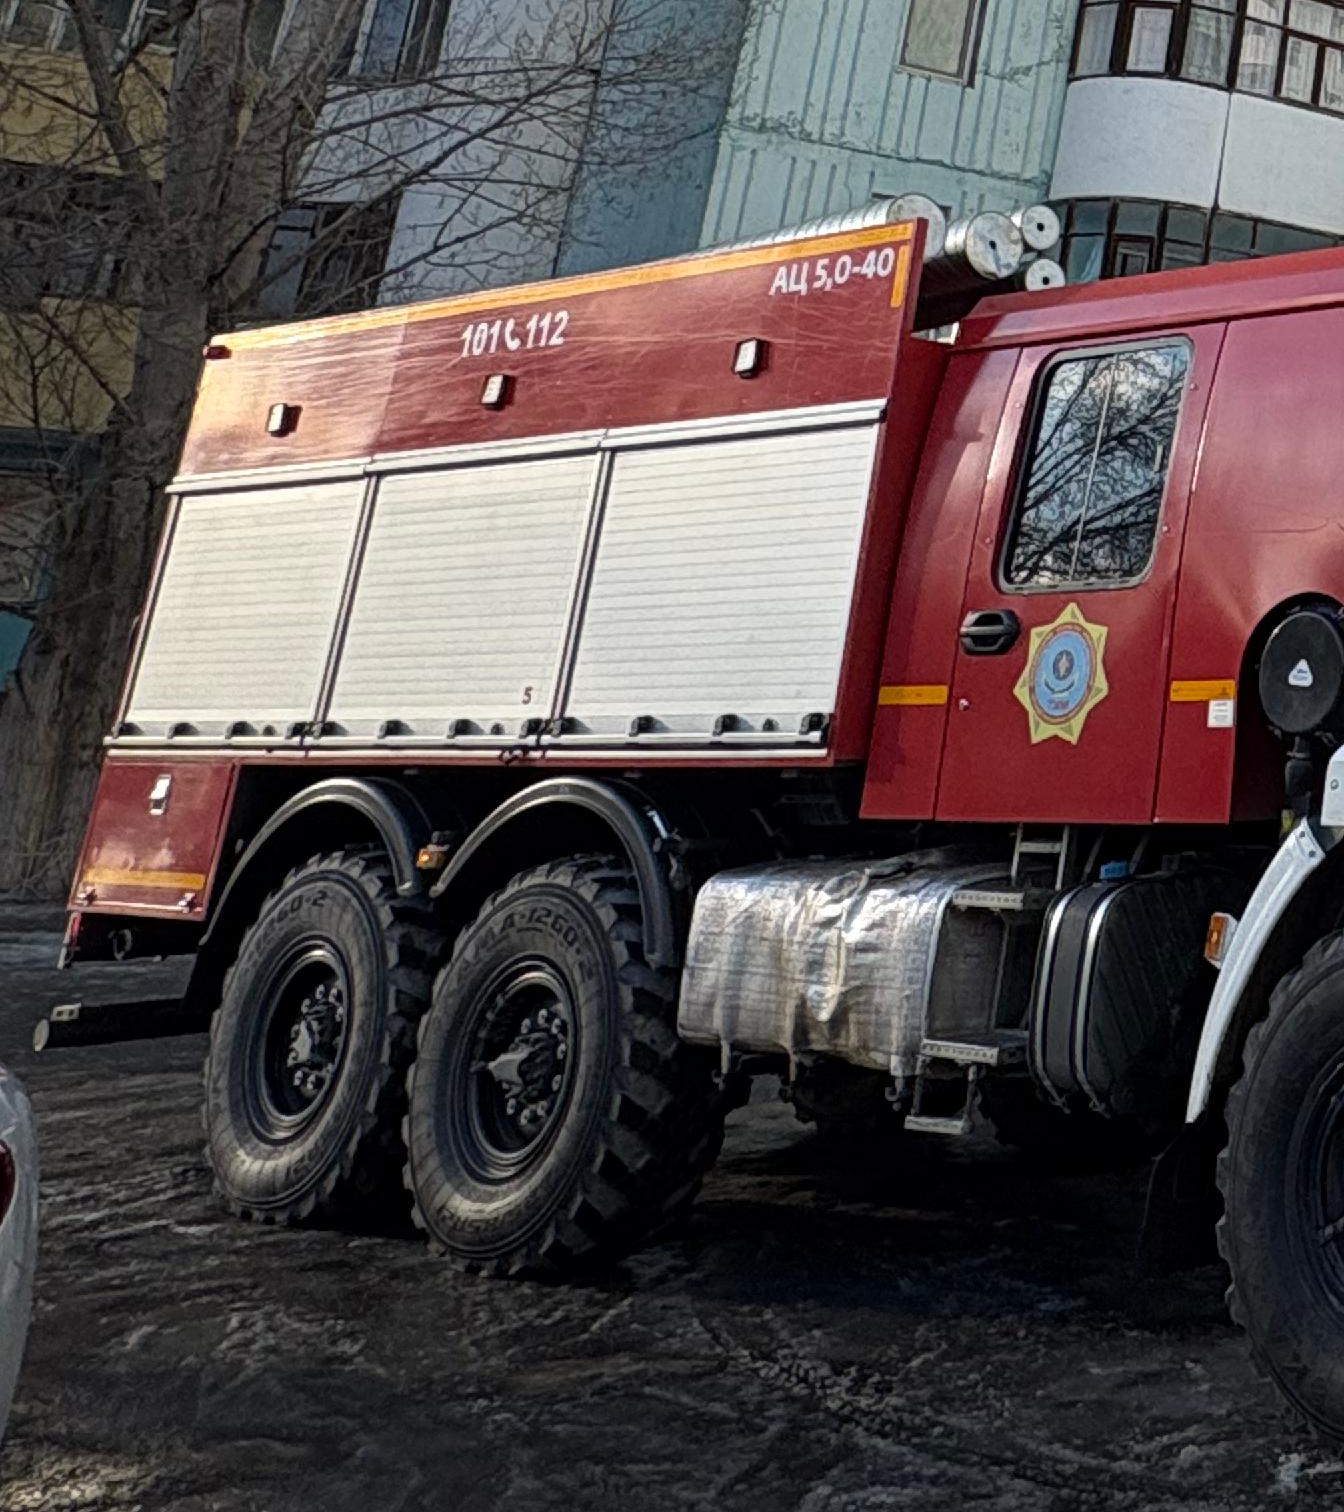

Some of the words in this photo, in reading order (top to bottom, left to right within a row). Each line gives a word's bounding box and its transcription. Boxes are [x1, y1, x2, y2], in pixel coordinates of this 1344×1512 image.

[768, 261, 809, 296] АЦ
[812, 247, 896, 292] 5,0-40
[461, 320, 501, 358] 101
[526, 310, 570, 349] 112
[521, 686, 534, 705] 5
